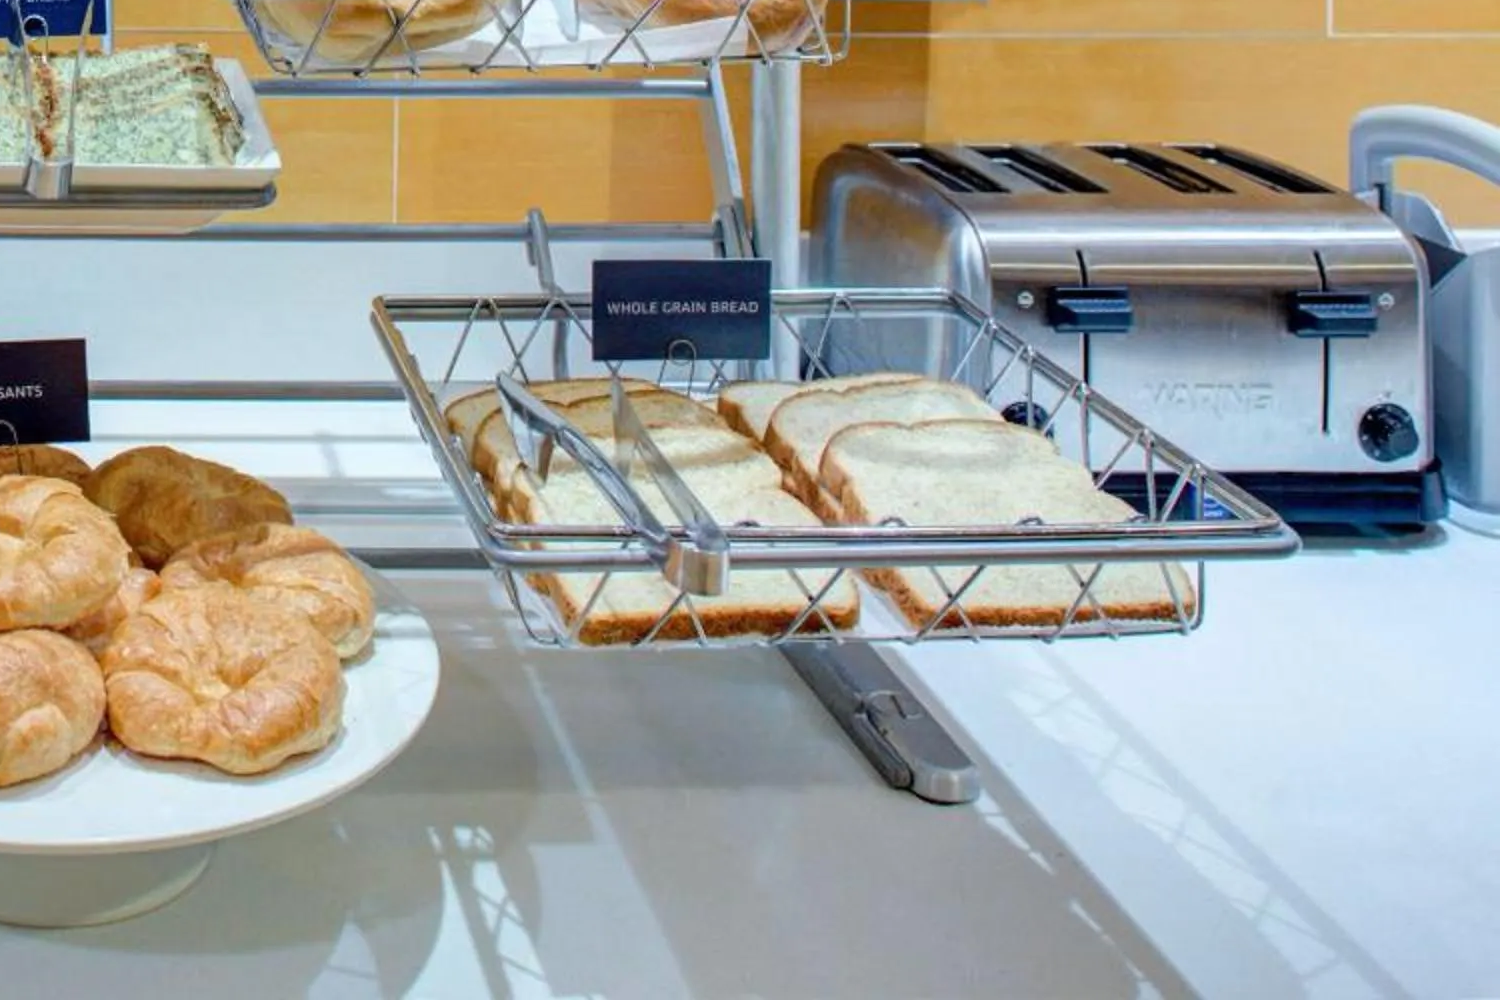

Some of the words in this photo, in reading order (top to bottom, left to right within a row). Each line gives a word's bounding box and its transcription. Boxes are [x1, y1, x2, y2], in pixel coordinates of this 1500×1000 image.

[607, 301, 658, 315] WHOLE
[662, 301, 706, 314] GRAIN
[711, 301, 759, 314] BREAD
